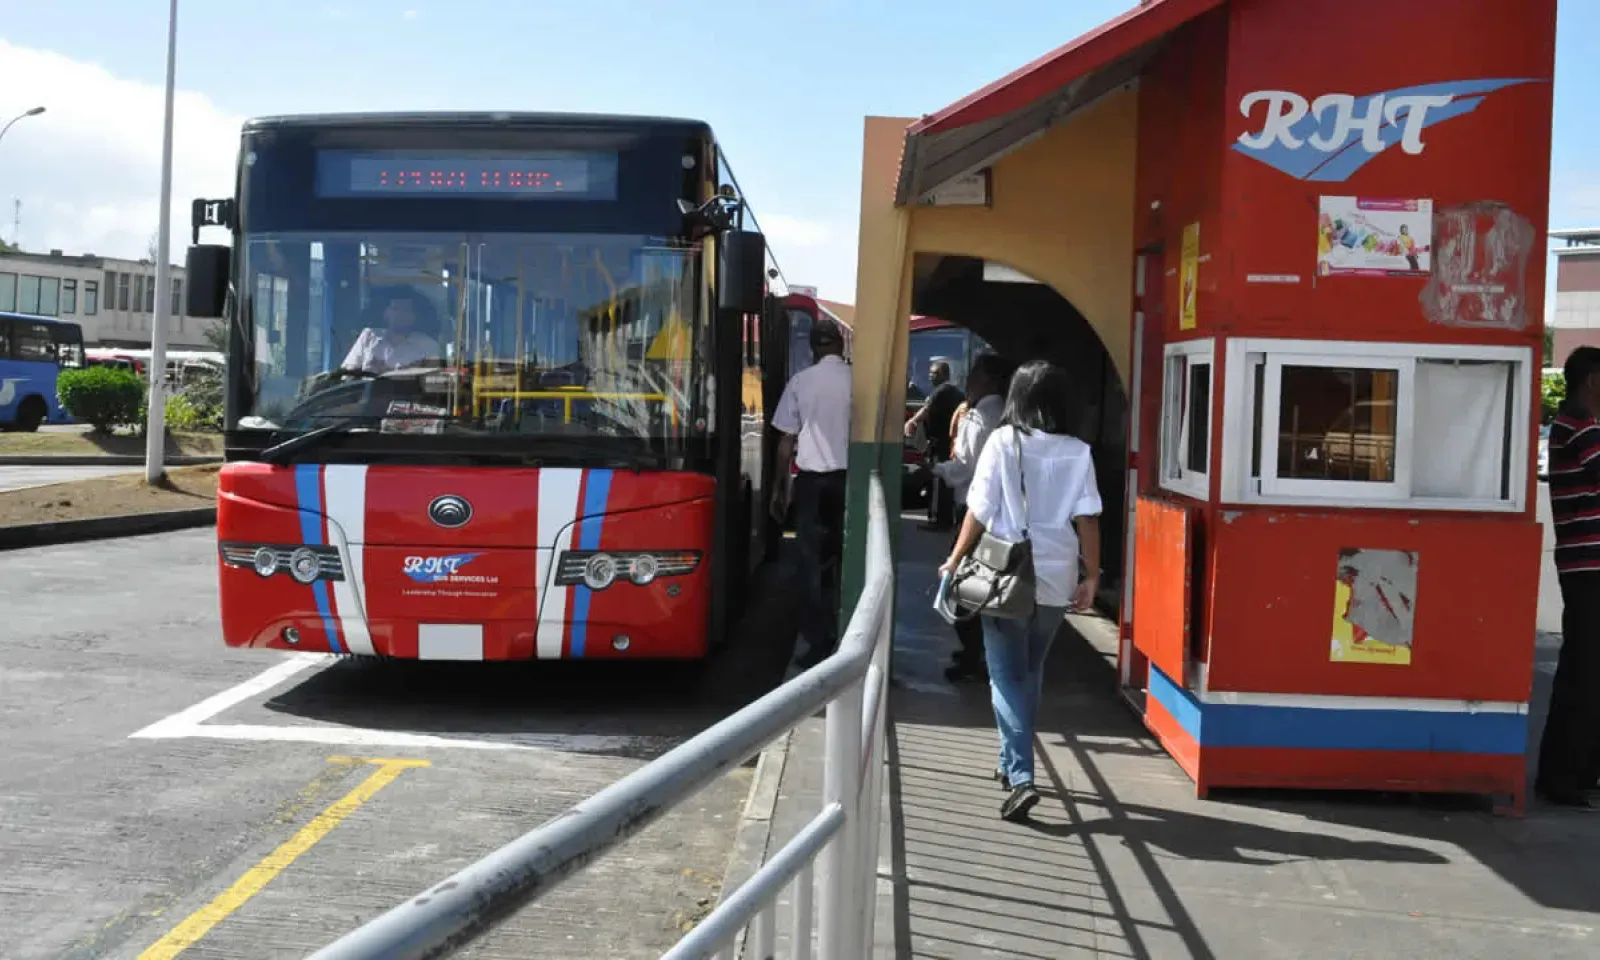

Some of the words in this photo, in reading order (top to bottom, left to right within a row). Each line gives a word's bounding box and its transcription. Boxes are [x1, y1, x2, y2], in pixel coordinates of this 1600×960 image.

[1237, 90, 1455, 156] RHT
[404, 556, 461, 574] RHT
[450, 575, 485, 583] SERVICES
